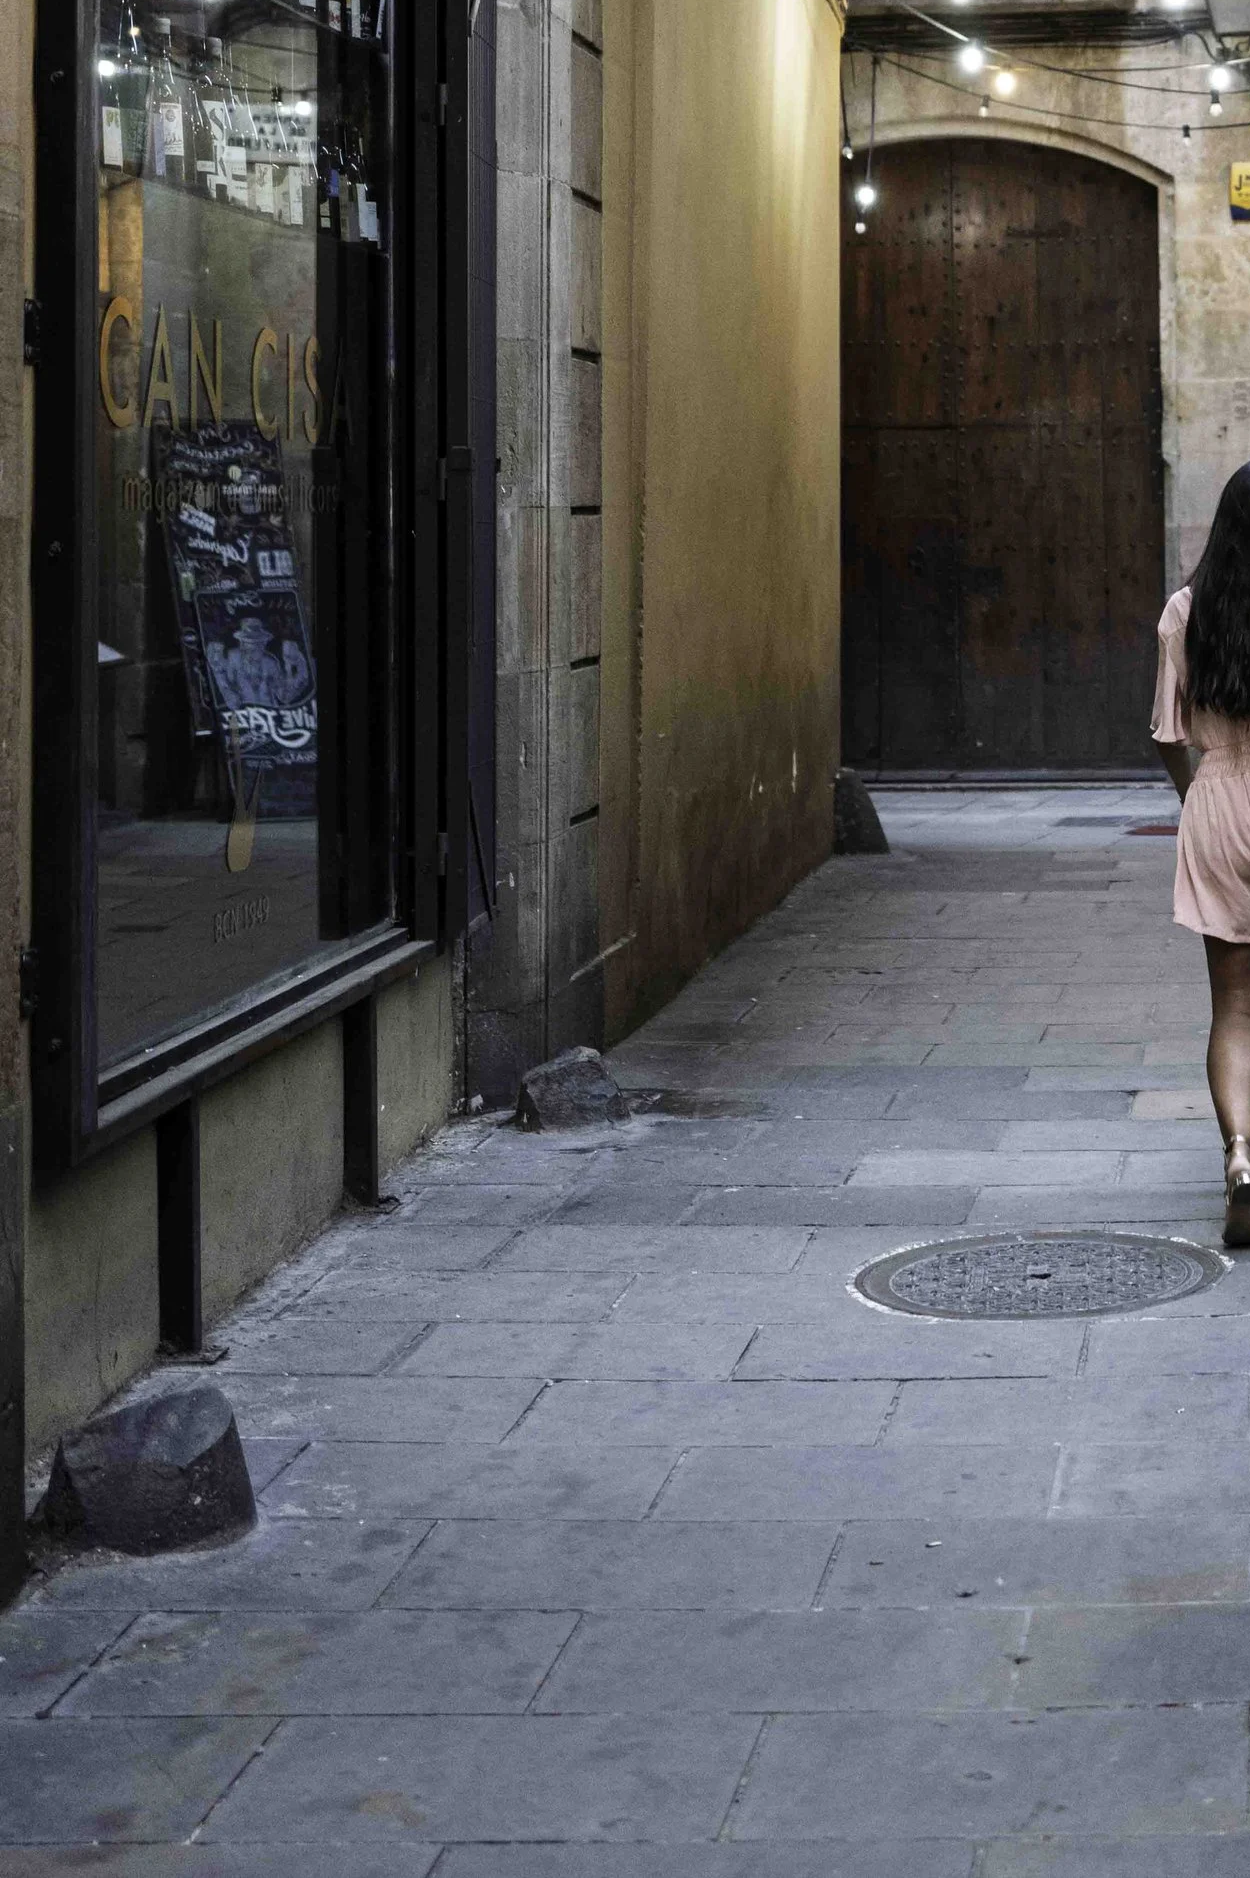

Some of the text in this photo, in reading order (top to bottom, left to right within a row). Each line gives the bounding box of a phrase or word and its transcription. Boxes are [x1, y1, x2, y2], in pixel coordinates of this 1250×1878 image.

[99, 296, 355, 448] CAN CISA
[214, 894, 270, 943] BCN 1949
